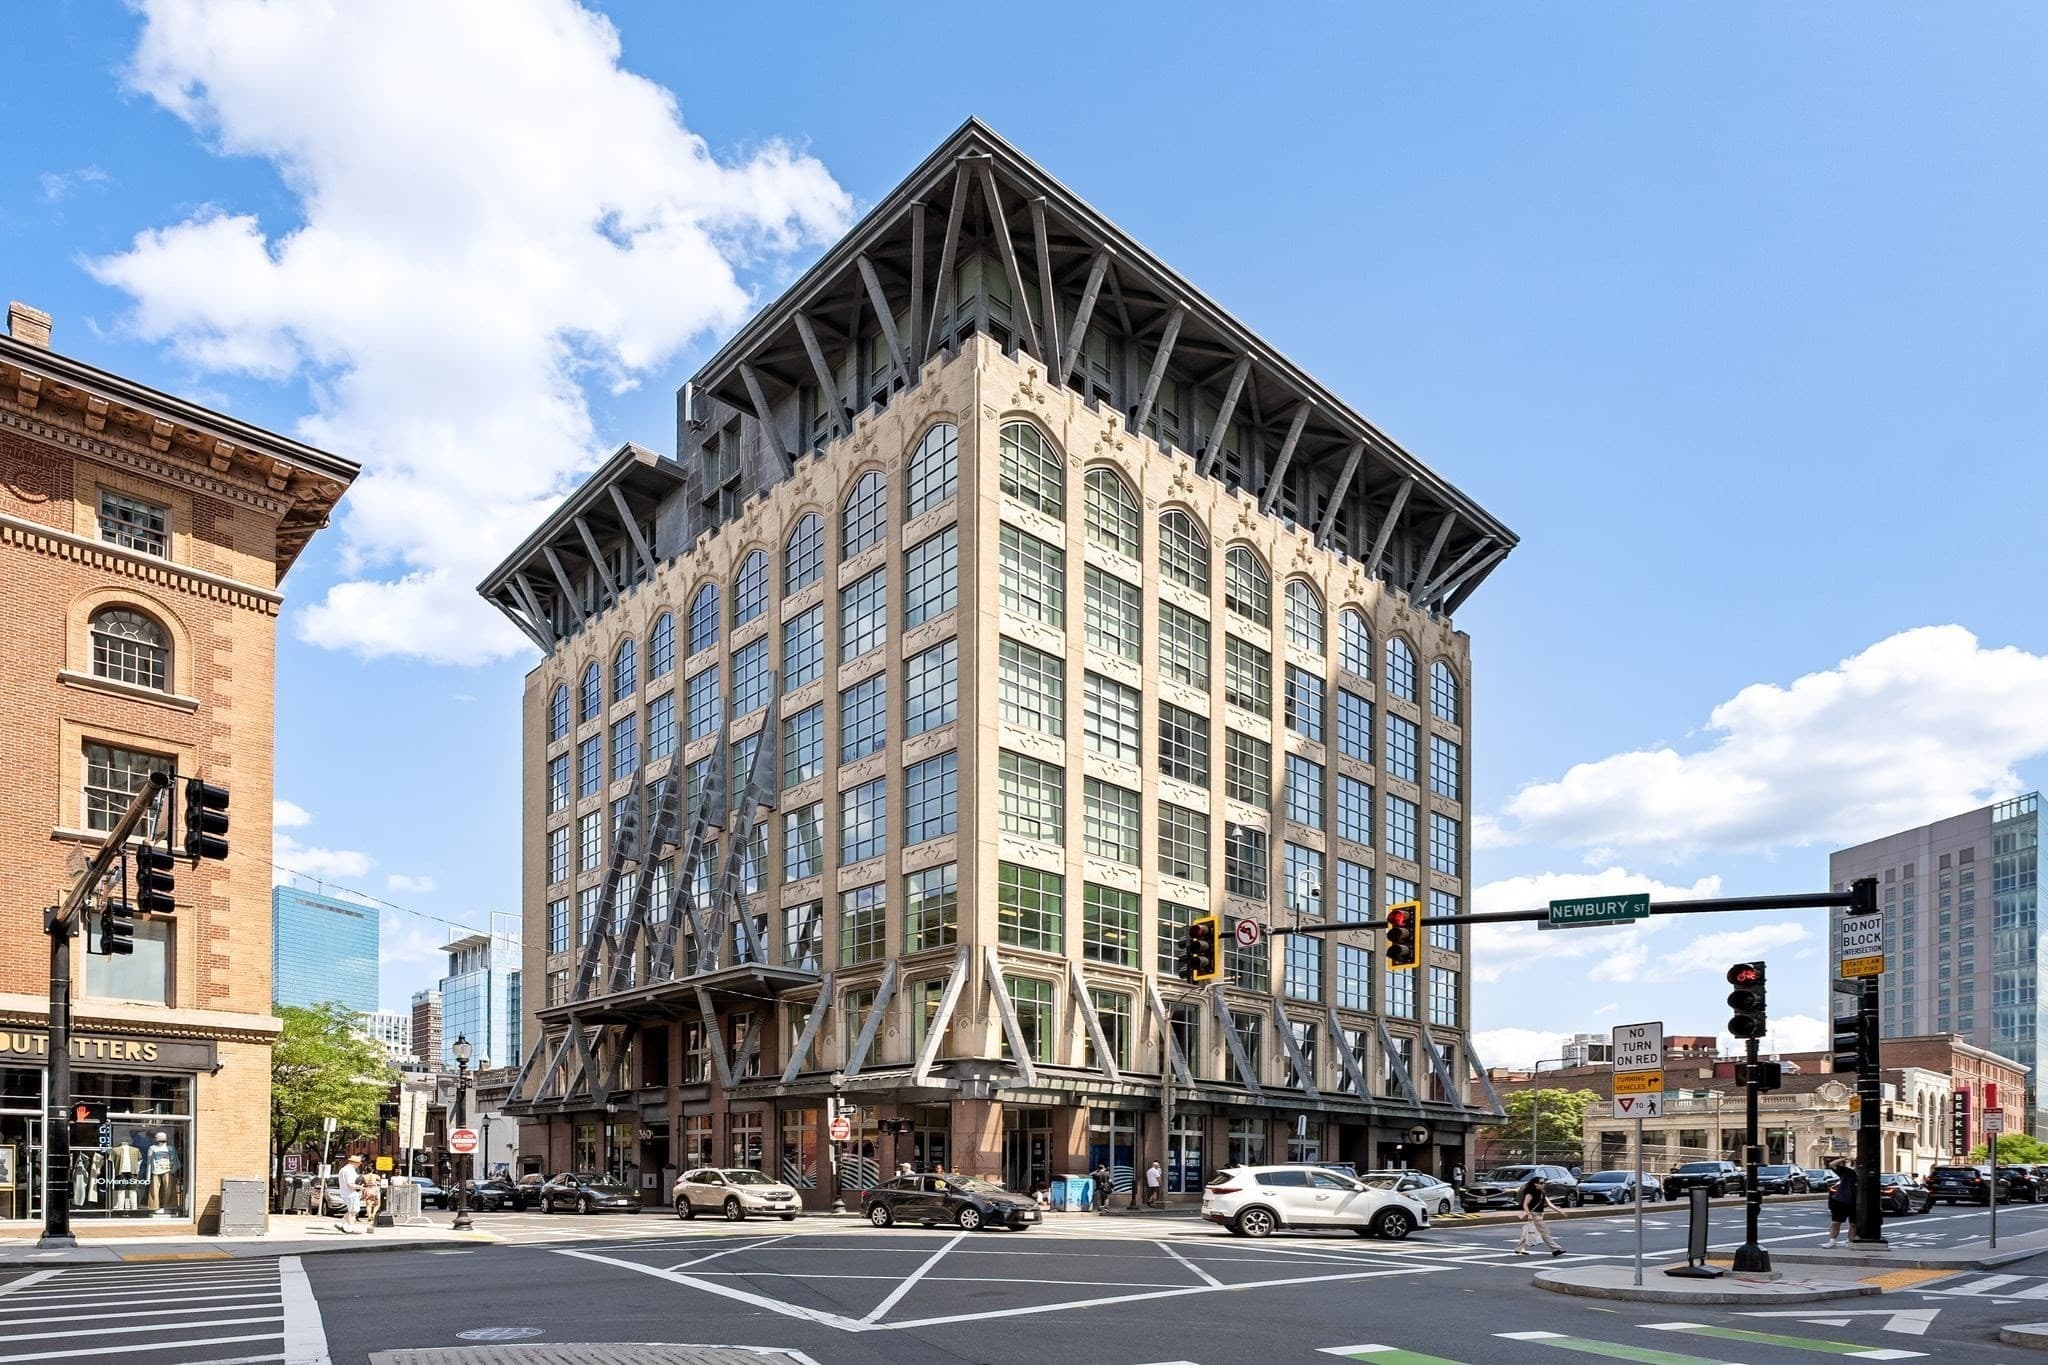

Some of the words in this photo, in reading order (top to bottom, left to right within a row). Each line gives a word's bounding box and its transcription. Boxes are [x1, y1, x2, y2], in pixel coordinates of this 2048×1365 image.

[1553, 901, 1628, 918] NEWBURY
[1634, 903, 1646, 913] ST
[1843, 923, 1858, 933] DO
[1860, 918, 1881, 930] NOT
[1843, 932, 1881, 947] BLOCK
[1843, 945, 1882, 955] INTERSECTION
[1629, 1028, 1645, 1038] NO
[0, 1031, 158, 1062] OUTTTERS
[1622, 1041, 1652, 1052] TURN
[1617, 1055, 1632, 1066] ON
[1636, 1053, 1658, 1064] RED
[1616, 1075, 1646, 1083] TURNING
[1955, 1094, 1963, 1154] BERKLEE
[1411, 1130, 1425, 1142] T
[130, 1178, 151, 1186] Shop
